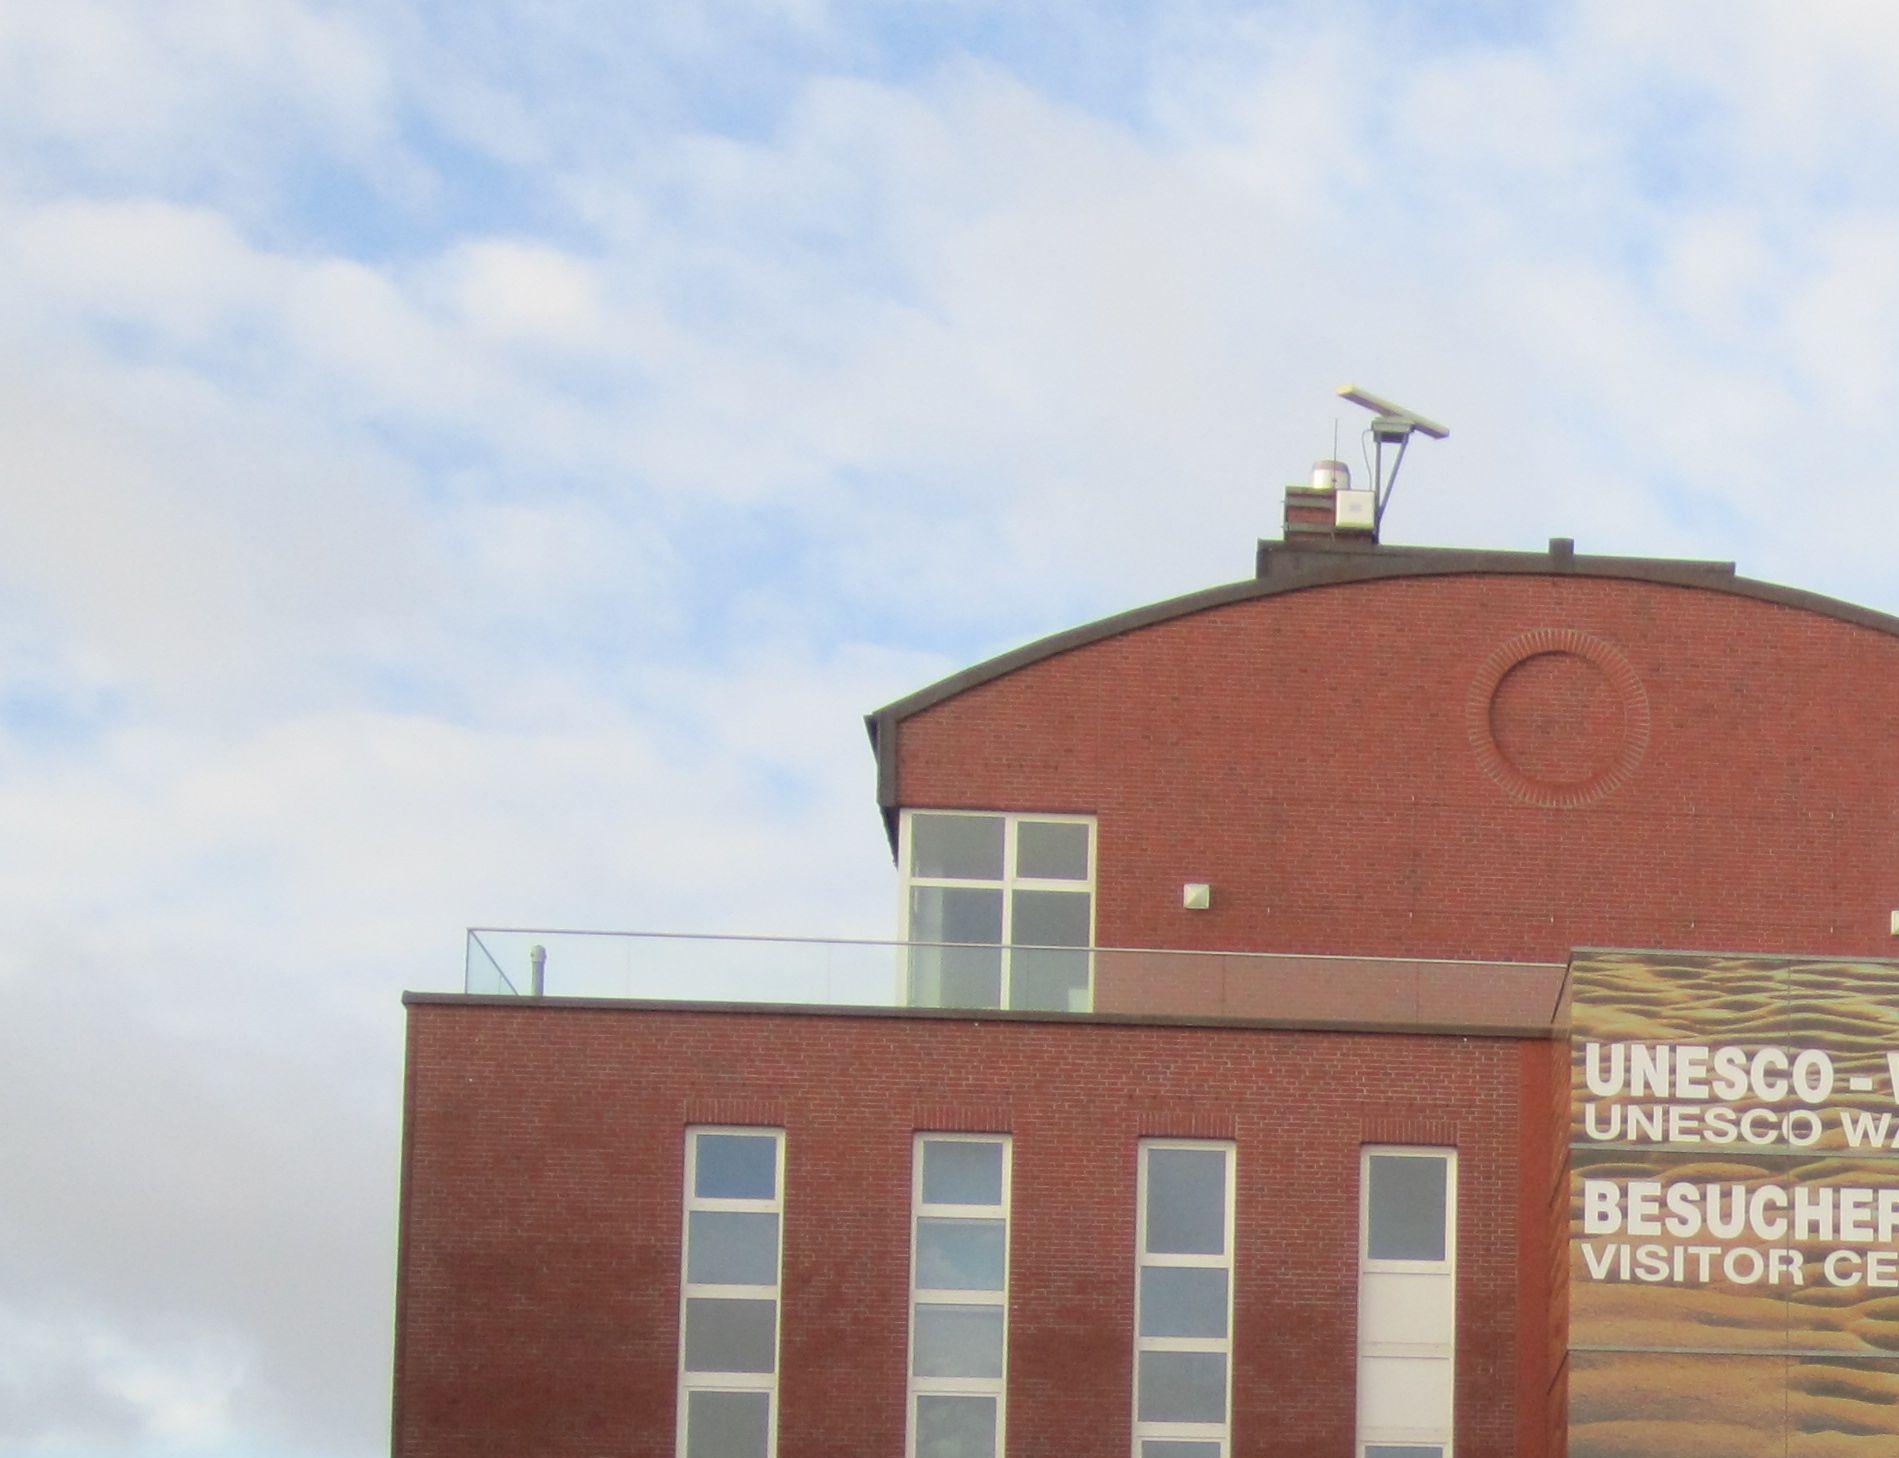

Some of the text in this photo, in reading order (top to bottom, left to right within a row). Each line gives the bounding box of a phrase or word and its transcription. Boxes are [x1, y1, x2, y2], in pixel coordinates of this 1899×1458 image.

[1584, 1042, 1835, 1104] UNESCO
[1584, 1104, 1823, 1147] UNESCO
[1581, 1243, 1805, 1287] VISITOR
